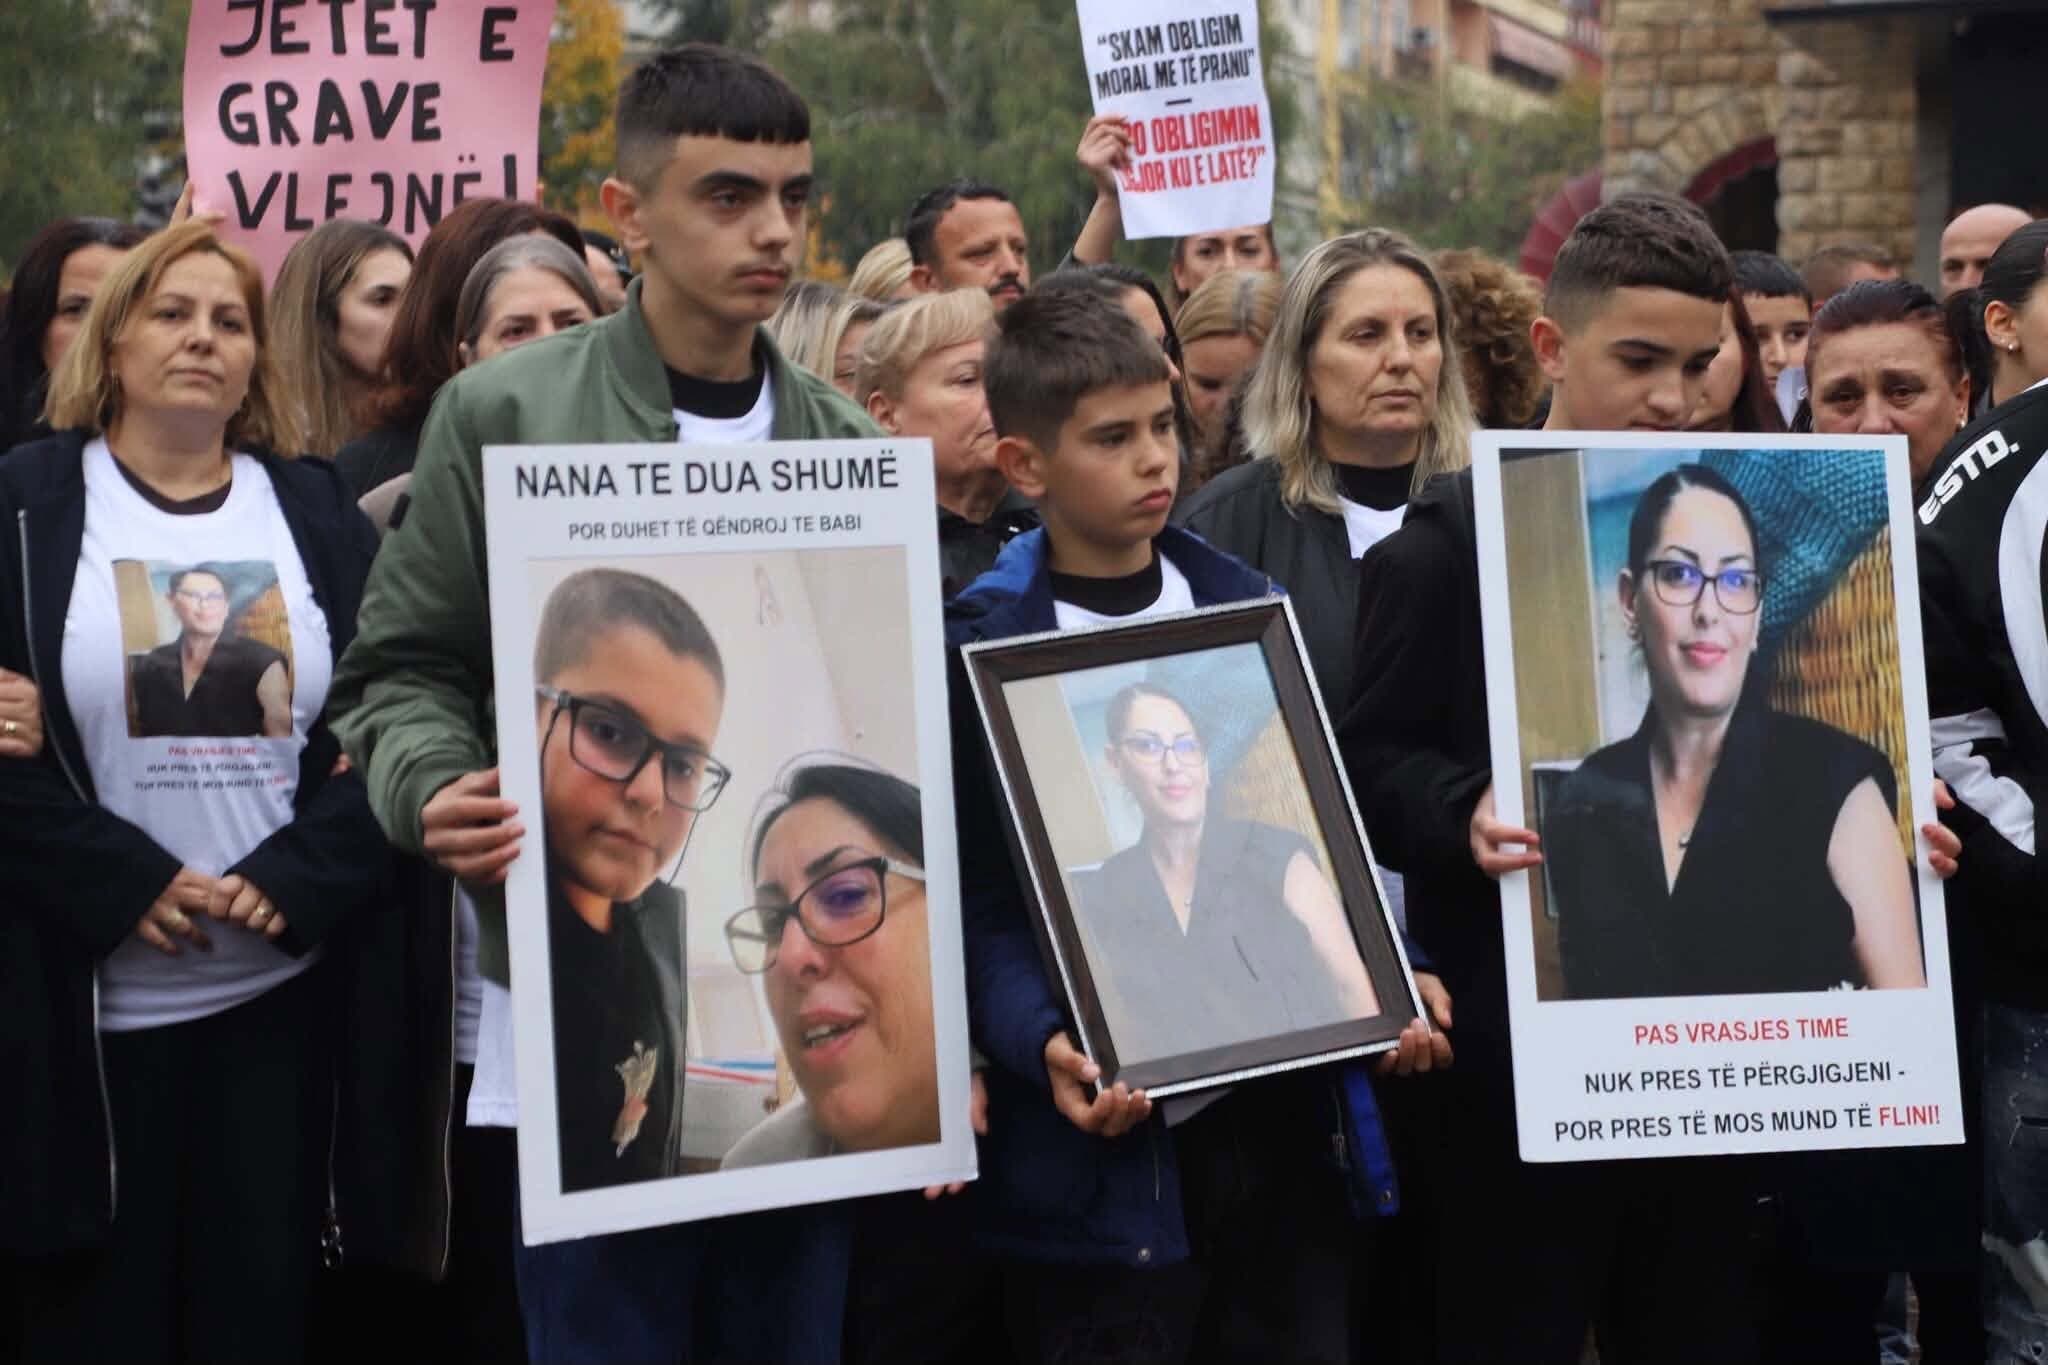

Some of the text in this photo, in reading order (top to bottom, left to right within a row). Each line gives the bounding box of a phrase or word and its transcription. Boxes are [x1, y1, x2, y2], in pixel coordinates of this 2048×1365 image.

[220, 0, 518, 62] JETET E
[1166, 14, 1244, 51] OBLIGIM
[1096, 64, 1151, 99] MORAL
[1154, 59, 1177, 89] ME
[1180, 54, 1198, 85] TË
[218, 79, 442, 145] GRAVE
[1150, 104, 1261, 154] OBLIGIMIN
[1169, 155, 1194, 190] KU
[1195, 155, 1206, 186] E
[515, 449, 900, 498] NANA TE DUA SHUMË
[1917, 429, 2021, 526] ESTD.
[569, 514, 862, 541] POR DUHET TË QËNDROJ TE BABI
[1635, 1018, 1849, 1045] PAS VRASJES TIME
[1585, 1071, 1633, 1094] NUK
[1641, 1069, 1701, 1091] PRES
[1708, 1063, 1737, 1088] TË
[1744, 1061, 1892, 1087] PËRGJIGJENI
[1555, 1103, 1941, 1142] POR PRES TË MOS MUND TË FLINI!
